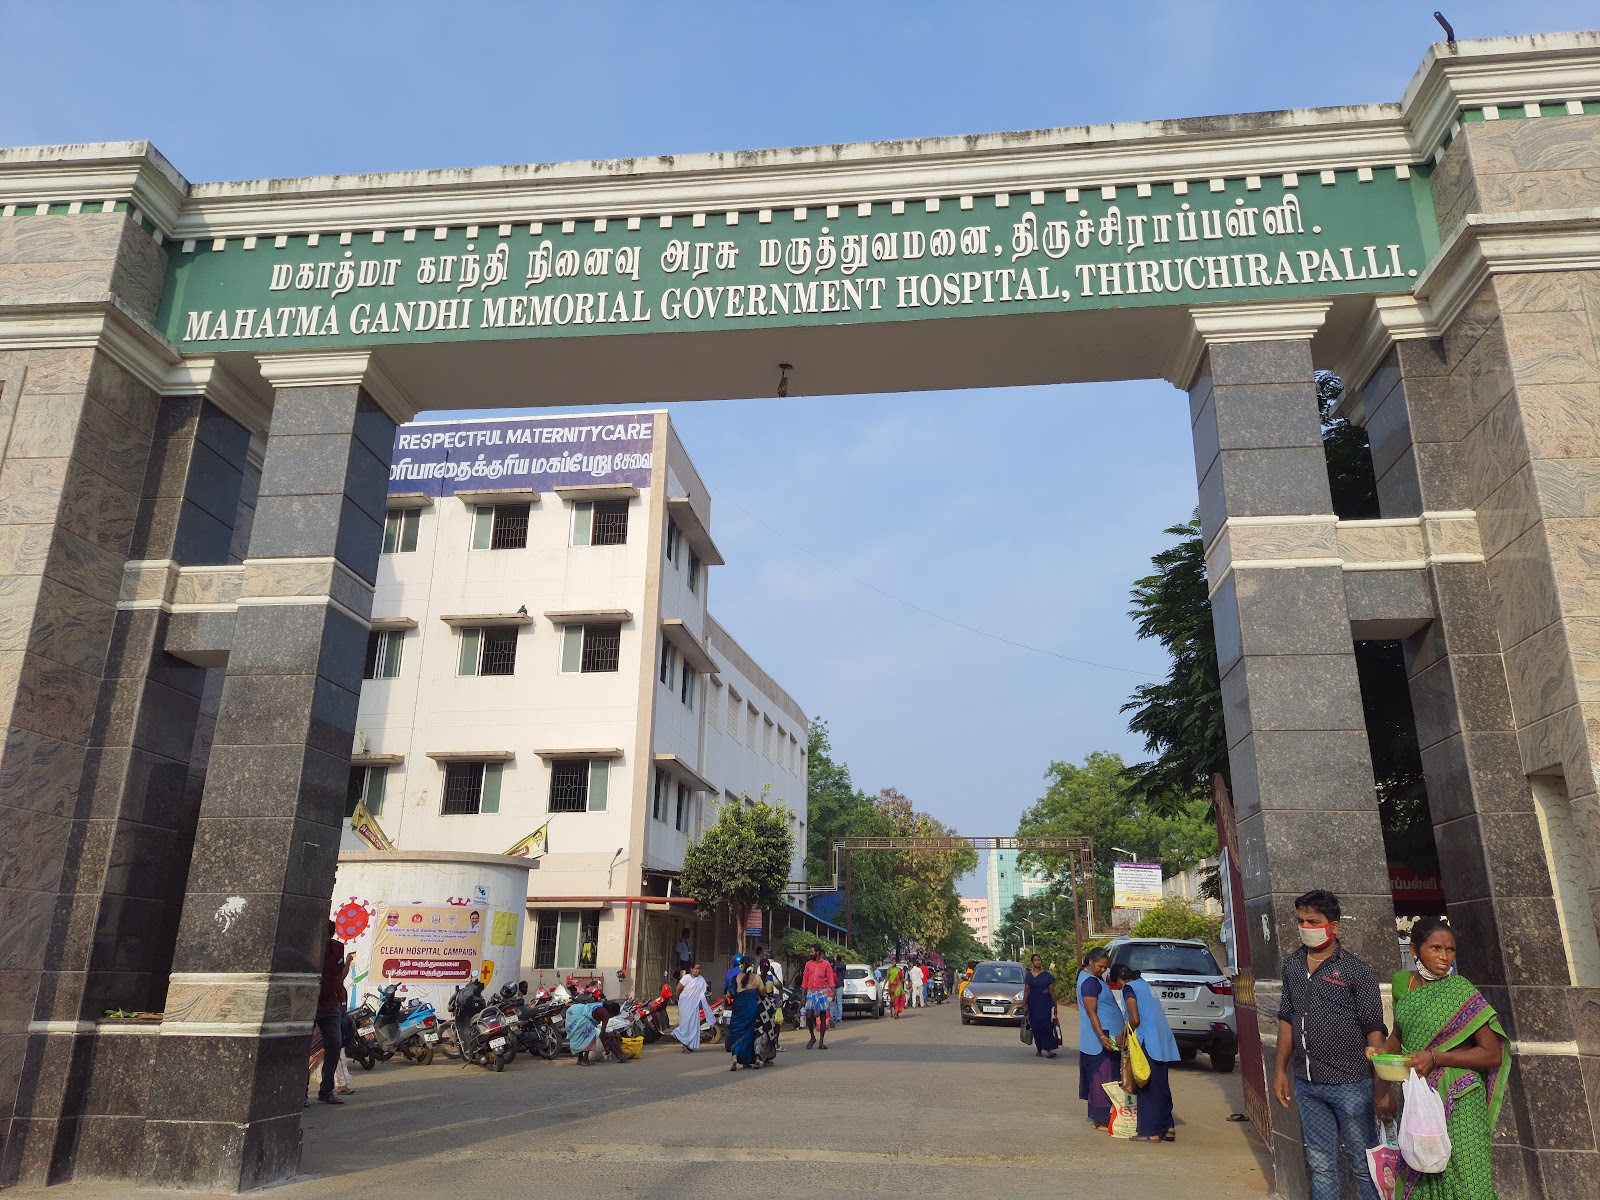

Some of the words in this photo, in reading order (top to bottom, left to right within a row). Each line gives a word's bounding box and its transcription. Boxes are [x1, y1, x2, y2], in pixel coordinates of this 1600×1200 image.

[268, 250, 402, 299] மகாத்மா
[416, 242, 511, 293] காந்தி
[524, 239, 643, 289] நினைவு
[660, 238, 740, 280] அரசு
[757, 226, 1003, 277] மருத்துவமனை,
[182, 304, 341, 341] MAHATMA
[349, 298, 474, 335] GANDHI
[479, 290, 653, 329] MEMORIAL
[660, 277, 886, 321] GOVERNMENT
[895, 268, 1071, 308] HOSPITAL,
[1075, 244, 1418, 297] THIRUCHIRAPALLI.
[398, 429, 504, 450] RESPECTFUL
[530, 450, 612, 477] மகப்பேறு
[380, 946, 404, 955] CLEAN
[406, 946, 441, 956] HOSPITAL
[443, 947, 477, 956] CAMPAIGN
[1161, 991, 1186, 999] 5005
